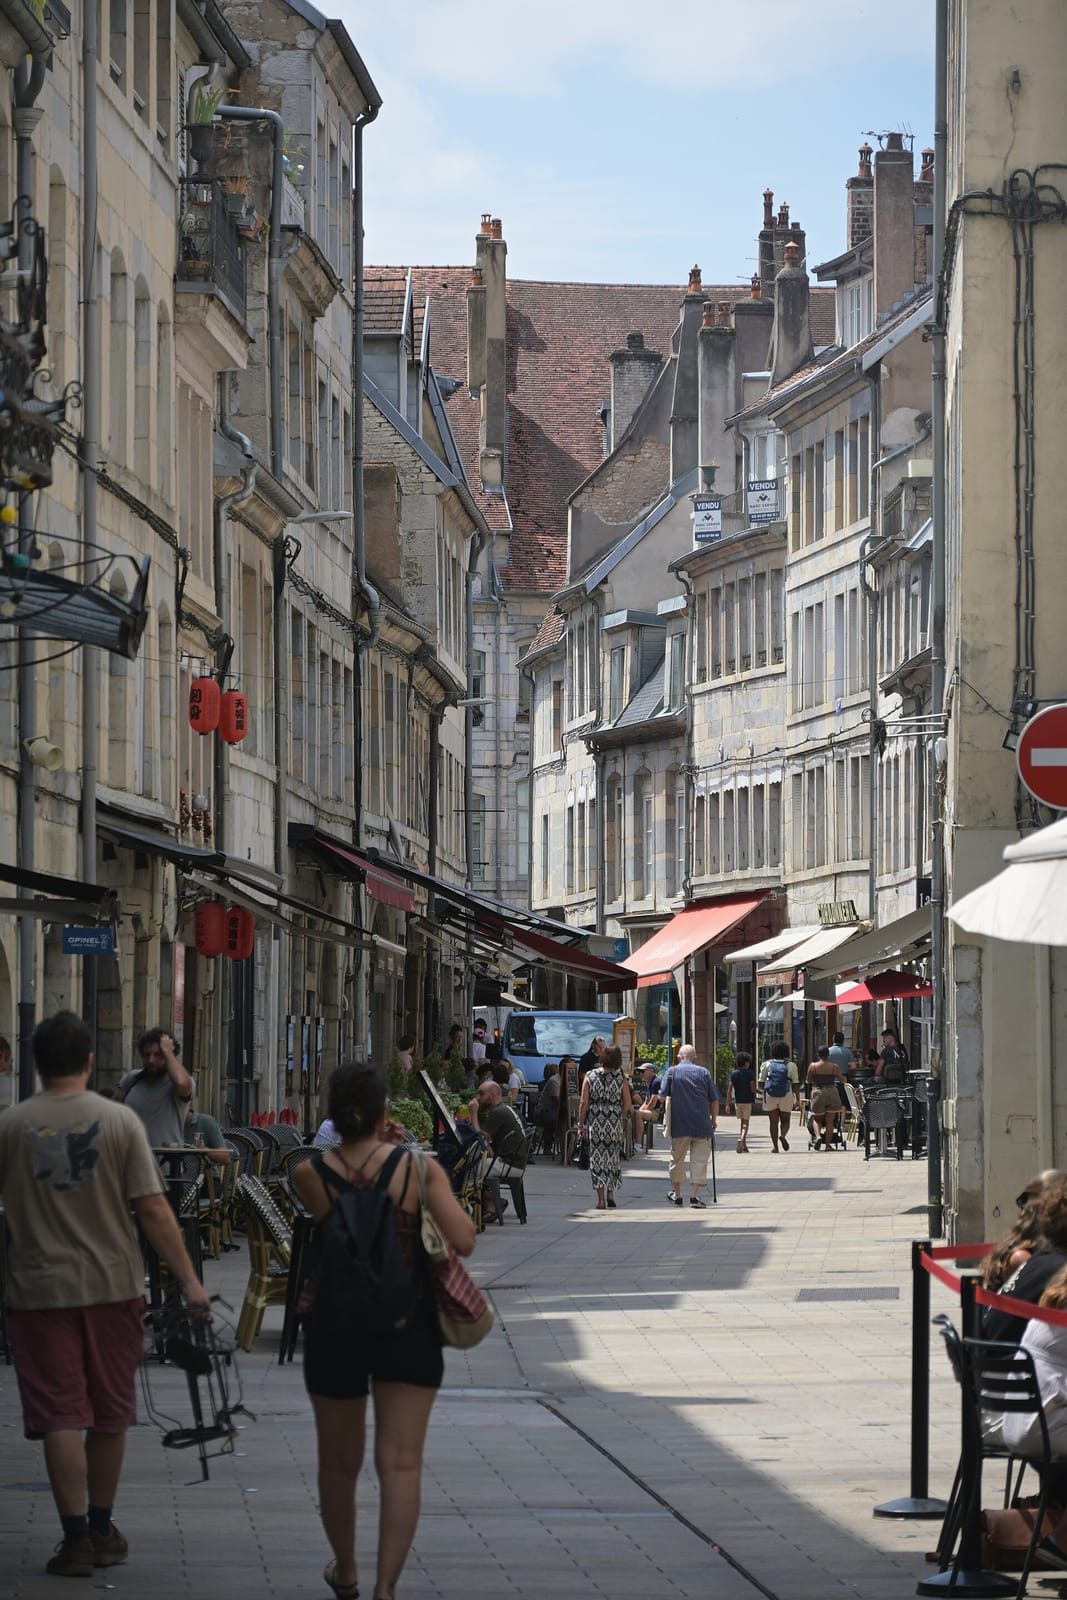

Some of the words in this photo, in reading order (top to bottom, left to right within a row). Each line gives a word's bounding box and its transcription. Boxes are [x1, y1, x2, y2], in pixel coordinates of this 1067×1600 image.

[749, 481, 776, 490] VENDU
[697, 502, 720, 510] VENDU
[67, 936, 101, 944] OPINEL
